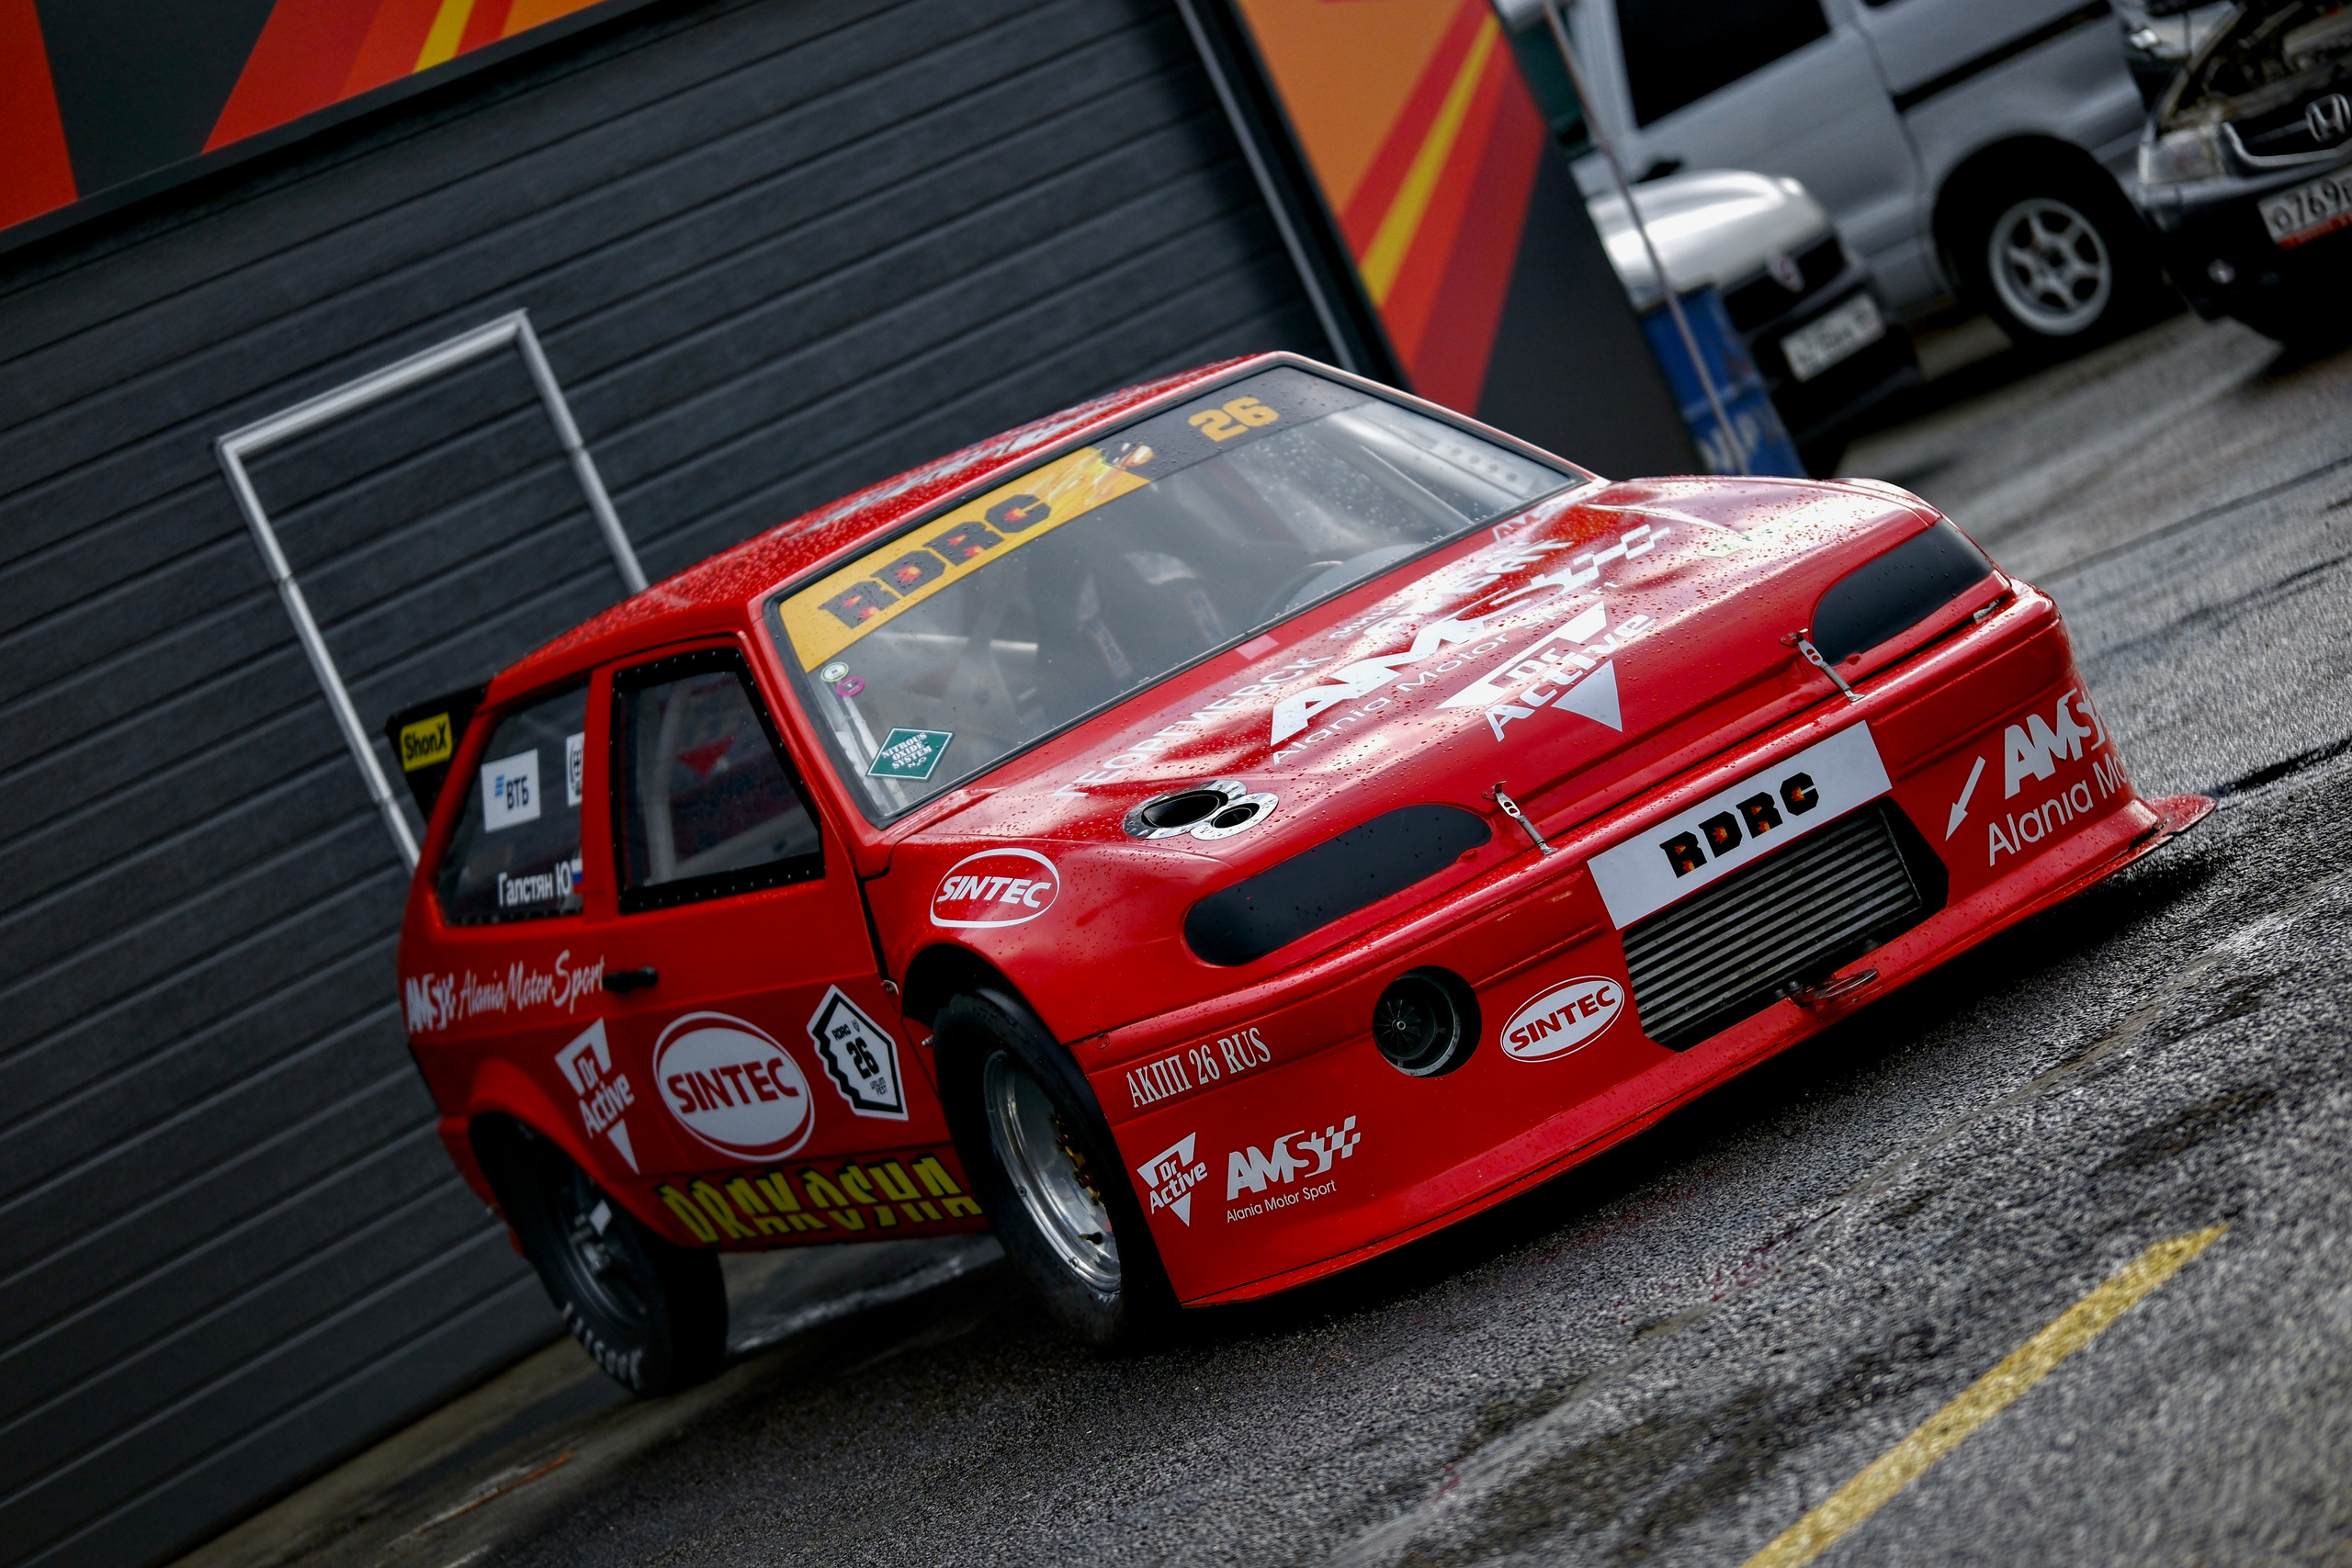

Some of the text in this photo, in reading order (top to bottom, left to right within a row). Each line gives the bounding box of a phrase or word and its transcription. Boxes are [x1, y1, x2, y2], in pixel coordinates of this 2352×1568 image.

[1188, 396, 1280, 443] 26
[817, 493, 1052, 629] RDRC
[1272, 697, 1392, 764] Alania
[1396, 631, 1510, 693] Motor
[1485, 615, 1657, 742] Active
[404, 721, 447, 760] ShonX
[882, 733, 927, 759] NITROUS
[892, 741, 924, 761] OXIDE
[892, 745, 933, 769] SYSTEM
[507, 775, 529, 810] ВТБ
[1659, 772, 1819, 879] RDRC
[1988, 779, 2094, 867] Alania
[936, 875, 1052, 908] SINTEC
[458, 949, 605, 1021] Alania Motor Sport
[1510, 986, 1615, 1052] SINTEC
[577, 1055, 600, 1090] Dr
[846, 1036, 879, 1079] 26
[1126, 1027, 1272, 1108] АКПП 26 RUS
[579, 1073, 635, 1139] Active
[667, 1057, 800, 1114] SINTEC
[1149, 1162, 1208, 1214] Active
[1159, 1157, 1178, 1182] Dr
[1227, 1179, 1337, 1224] Alania Motor Sport
